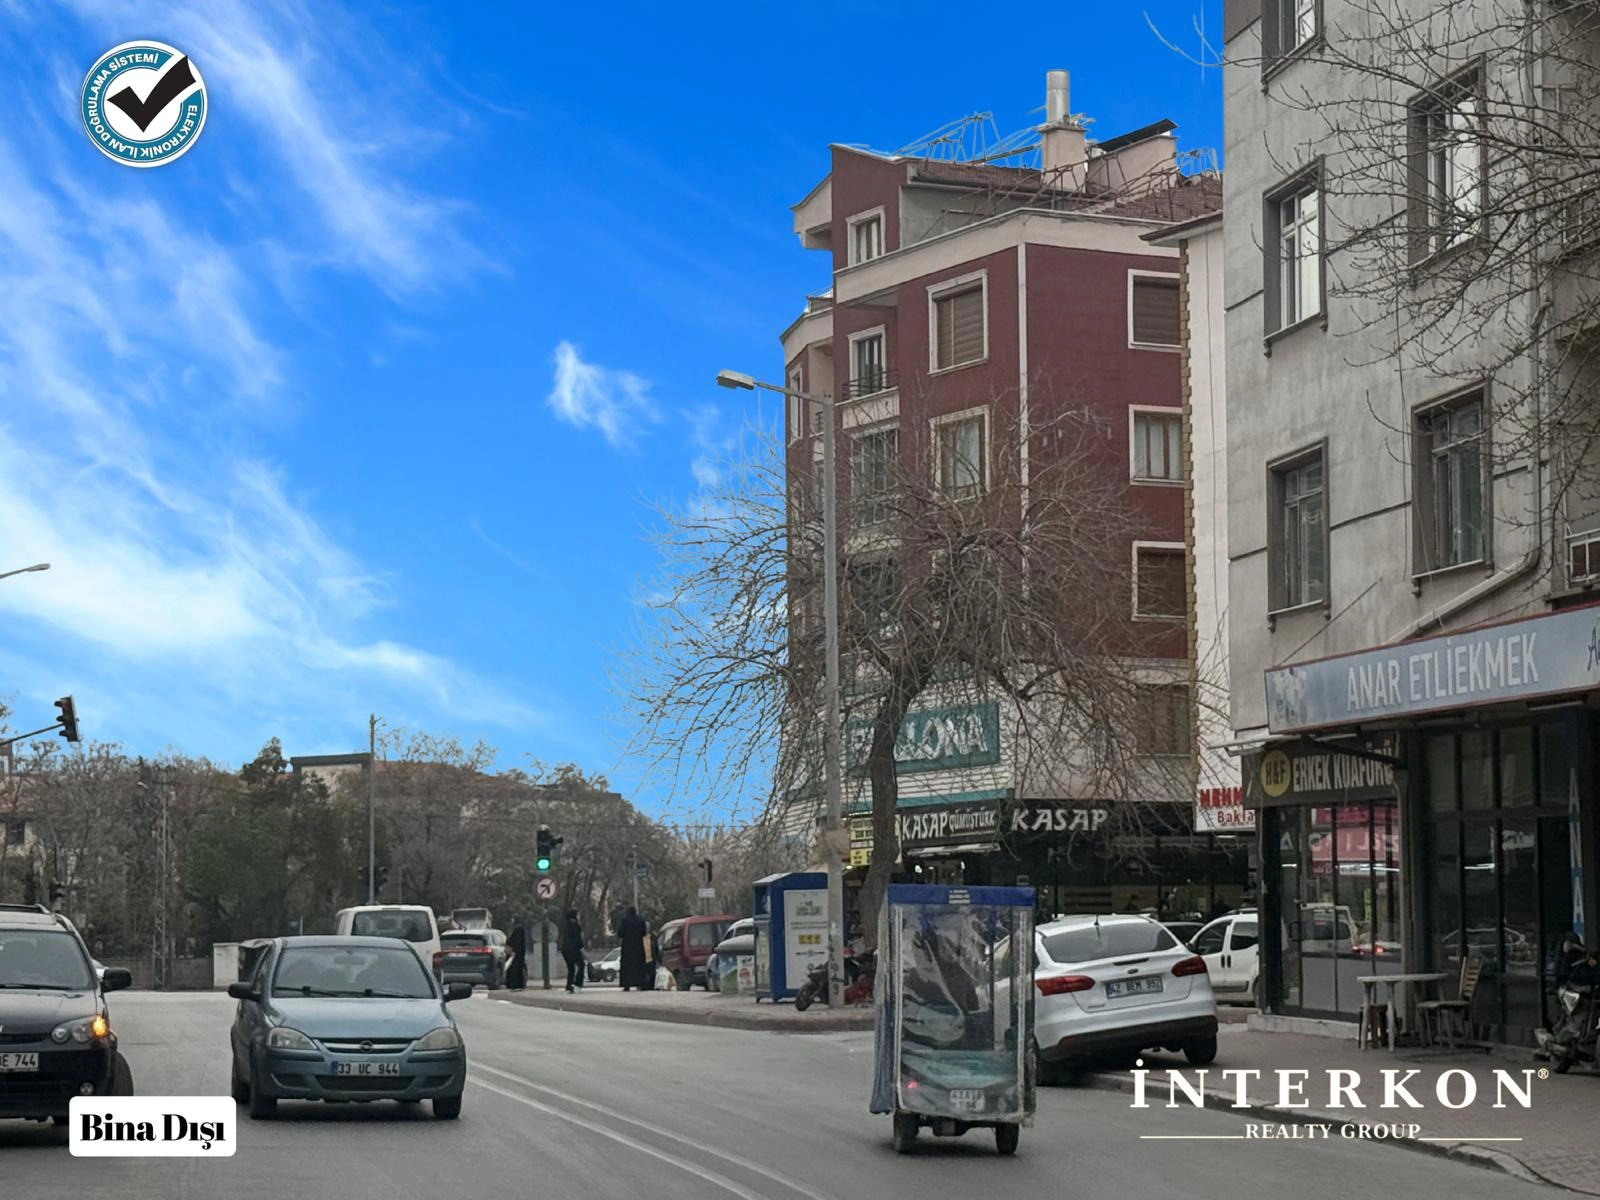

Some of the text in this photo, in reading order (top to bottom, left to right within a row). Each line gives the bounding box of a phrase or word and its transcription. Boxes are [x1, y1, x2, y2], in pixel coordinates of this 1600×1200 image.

[1347, 632, 1539, 711] ANAR ETLİEKMEK
[1293, 754, 1332, 792] ERKEK
[902, 812, 948, 840] KASAP
[1012, 808, 1108, 832] KASAP
[15, 1054, 36, 1067] 744
[338, 1063, 398, 1074] 33 UC 944
